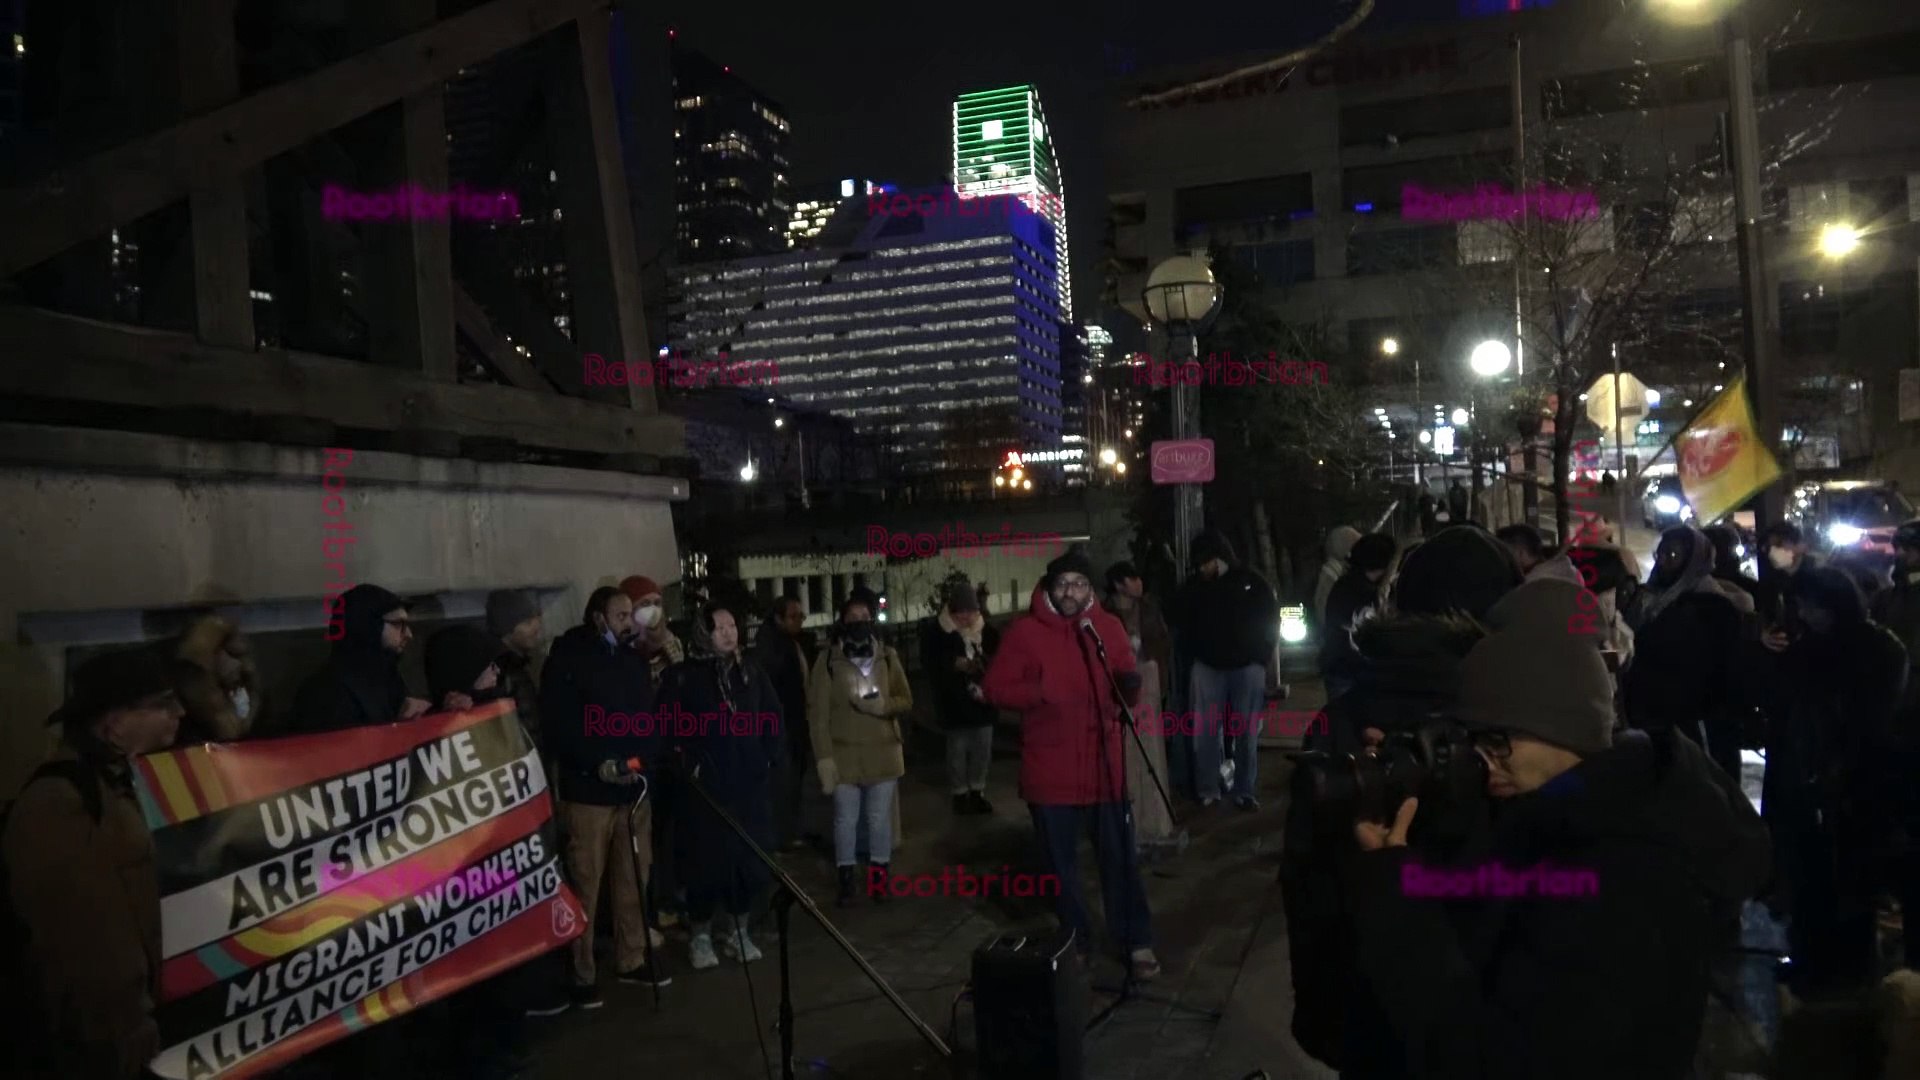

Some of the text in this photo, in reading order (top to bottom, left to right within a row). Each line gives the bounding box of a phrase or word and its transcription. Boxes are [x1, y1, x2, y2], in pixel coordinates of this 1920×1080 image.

[228, 761, 532, 930] ARE STRONGER
[260, 731, 482, 849] UNITED WE
[185, 868, 557, 1079] ALLIANCE FOR CHANG
[224, 834, 544, 1018] MIGRANT WORKERS
